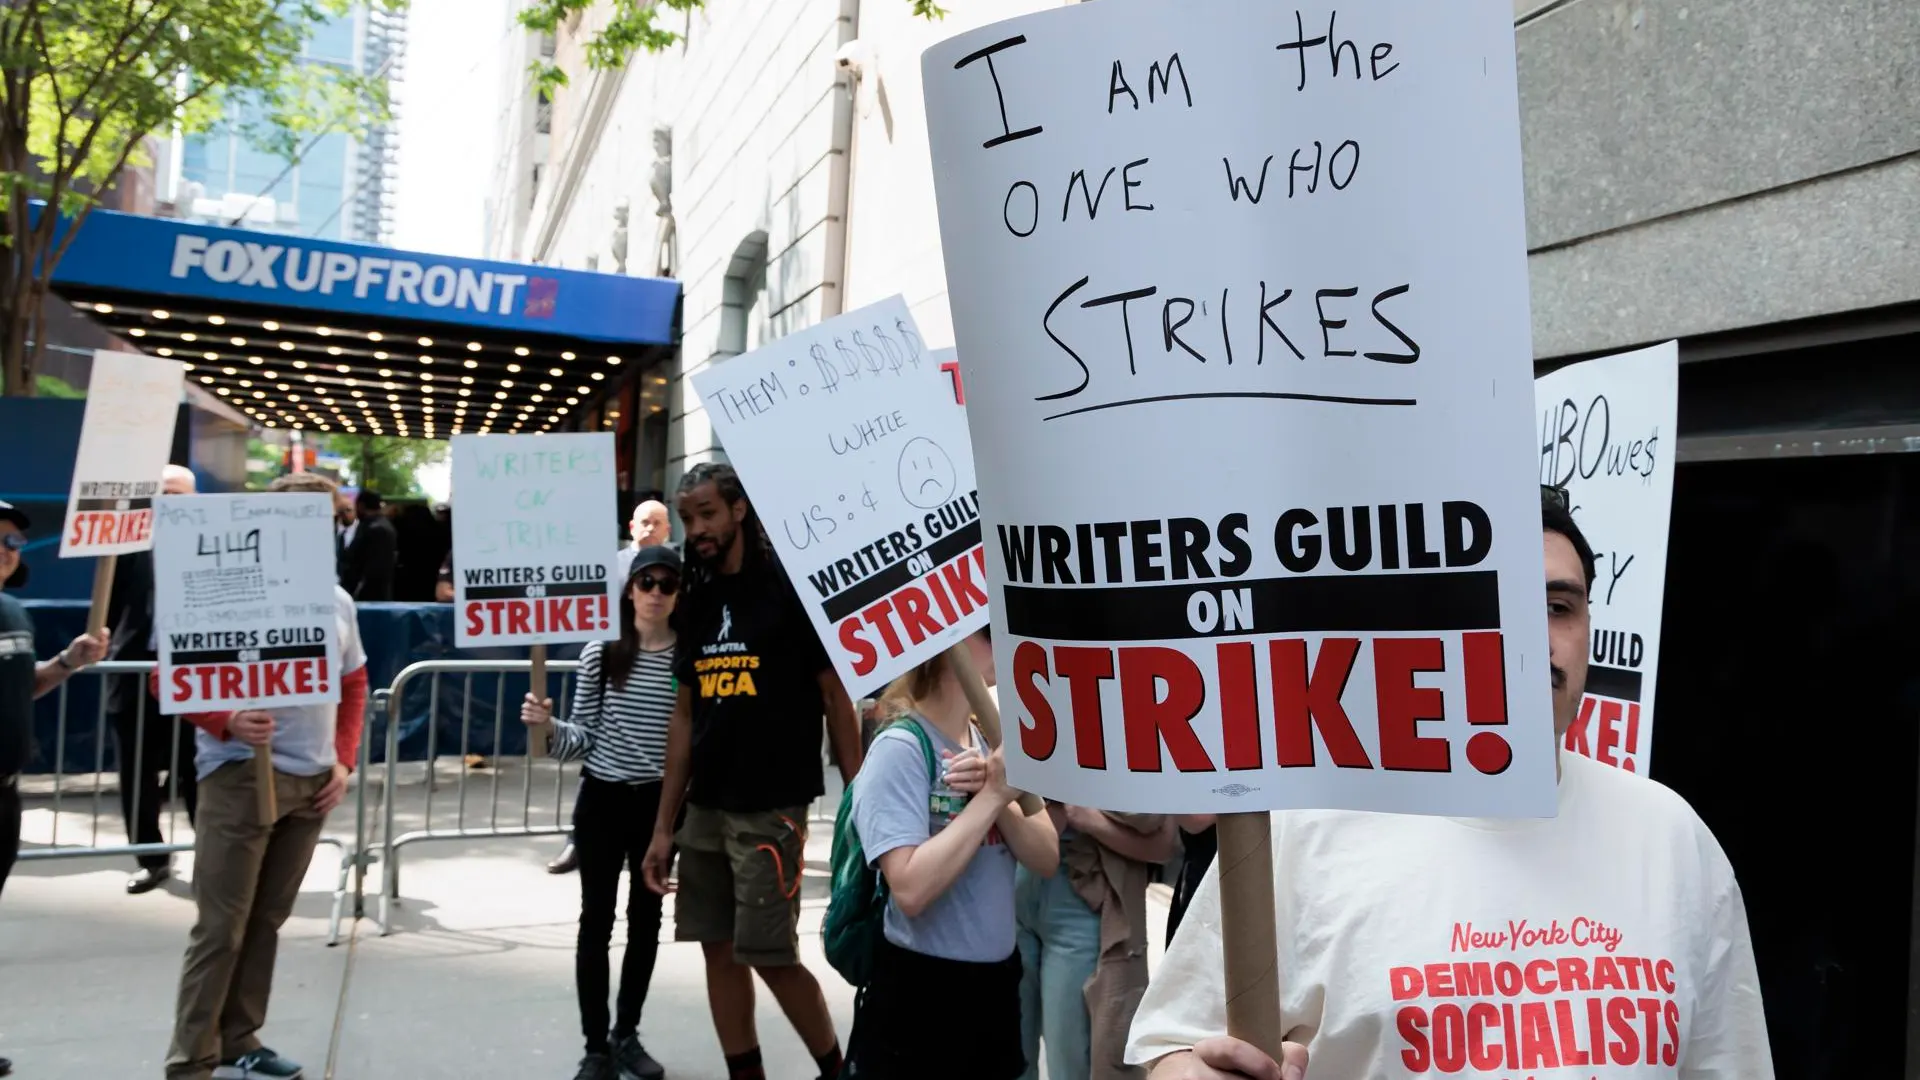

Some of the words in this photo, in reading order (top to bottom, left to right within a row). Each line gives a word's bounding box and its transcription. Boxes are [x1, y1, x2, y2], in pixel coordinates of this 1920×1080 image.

[953, 34, 1043, 148] I
[1108, 53, 1192, 113] AM
[1276, 10, 1400, 91] the
[1003, 157, 1154, 237] ONE
[1222, 139, 1360, 204] WHO
[170, 233, 283, 289] FOX
[283, 246, 526, 316] UPFRONT
[1034, 274, 1421, 401] STRIKES
[828, 409, 908, 455] WHILE
[472, 447, 602, 480] WRITERS
[808, 523, 923, 599] WRITERS
[907, 550, 934, 578] ON
[996, 512, 1253, 585] WRITERS
[1274, 500, 1493, 572] GUILD
[464, 565, 545, 585] WRITERS
[551, 564, 606, 582] GUILD
[526, 584, 546, 598] ON
[465, 596, 610, 636] STRIKE!
[838, 545, 988, 677] STRIK
[1186, 587, 1254, 633] ON
[170, 630, 258, 649] WRITERS
[266, 627, 325, 645] GUILD
[1593, 628, 1643, 668] UILD
[172, 657, 329, 702] STRIKE!
[1012, 630, 1513, 776] STRIKE!
[1571, 916, 1623, 952] City
[1389, 956, 1676, 1001] DEMOCRATIC
[1396, 996, 1680, 1073] SOCIALISTS
